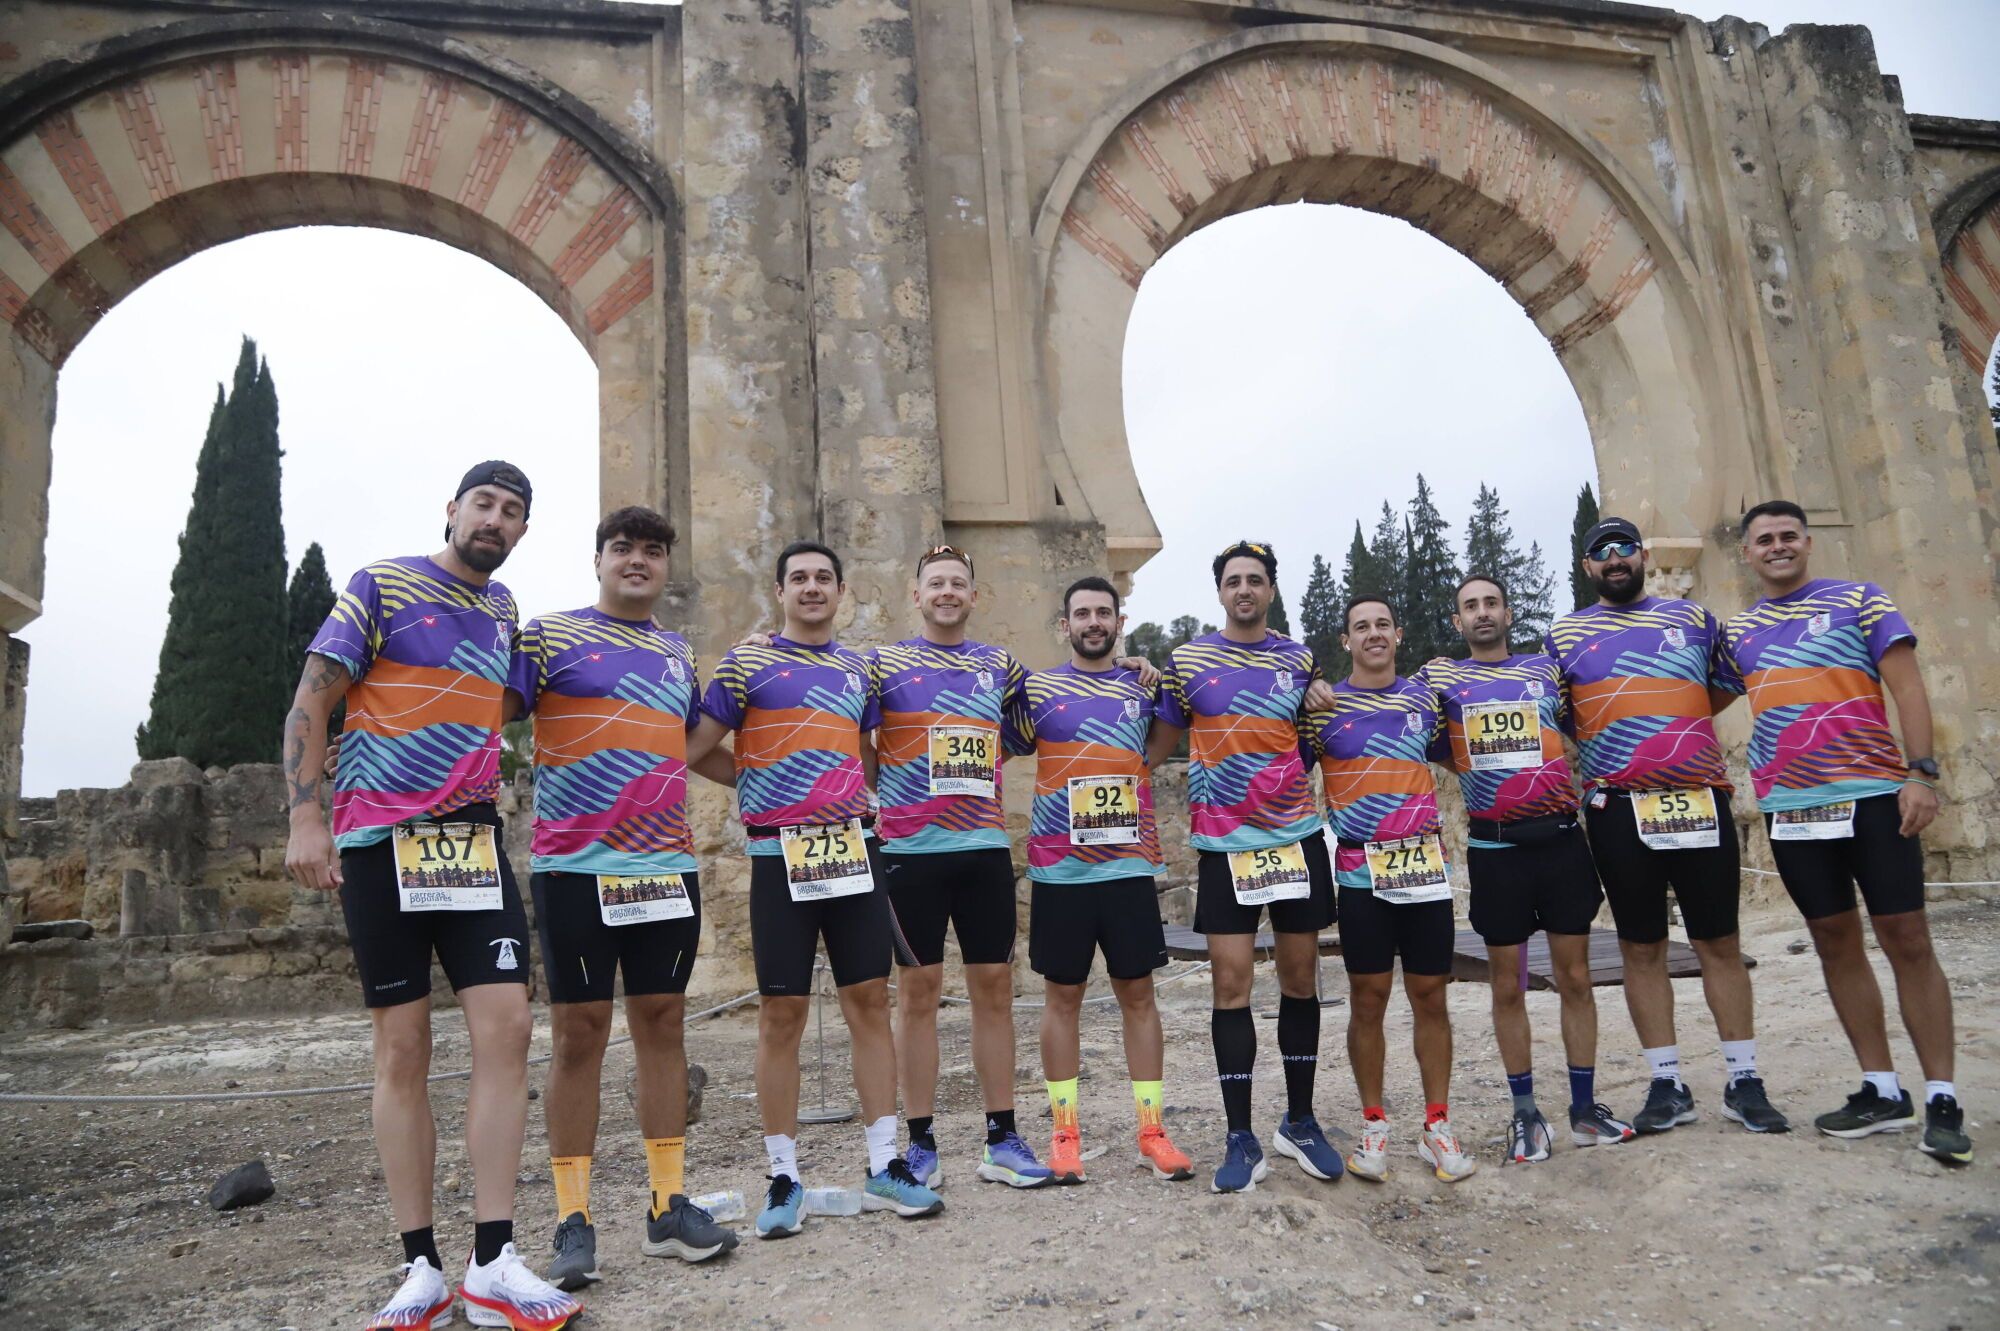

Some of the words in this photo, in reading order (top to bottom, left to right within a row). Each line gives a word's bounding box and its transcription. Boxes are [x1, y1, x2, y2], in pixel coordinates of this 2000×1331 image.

[1480, 711, 1524, 733] 190
[947, 737, 986, 758] 348
[1094, 786, 1122, 807] 92
[1659, 793, 1690, 813] 55
[416, 836, 473, 862] 107
[801, 832, 849, 858] 275
[1253, 849, 1282, 869] 56
[1384, 846, 1427, 869] 274
[410, 891, 446, 899] carreras
[410, 895, 452, 905] populares
